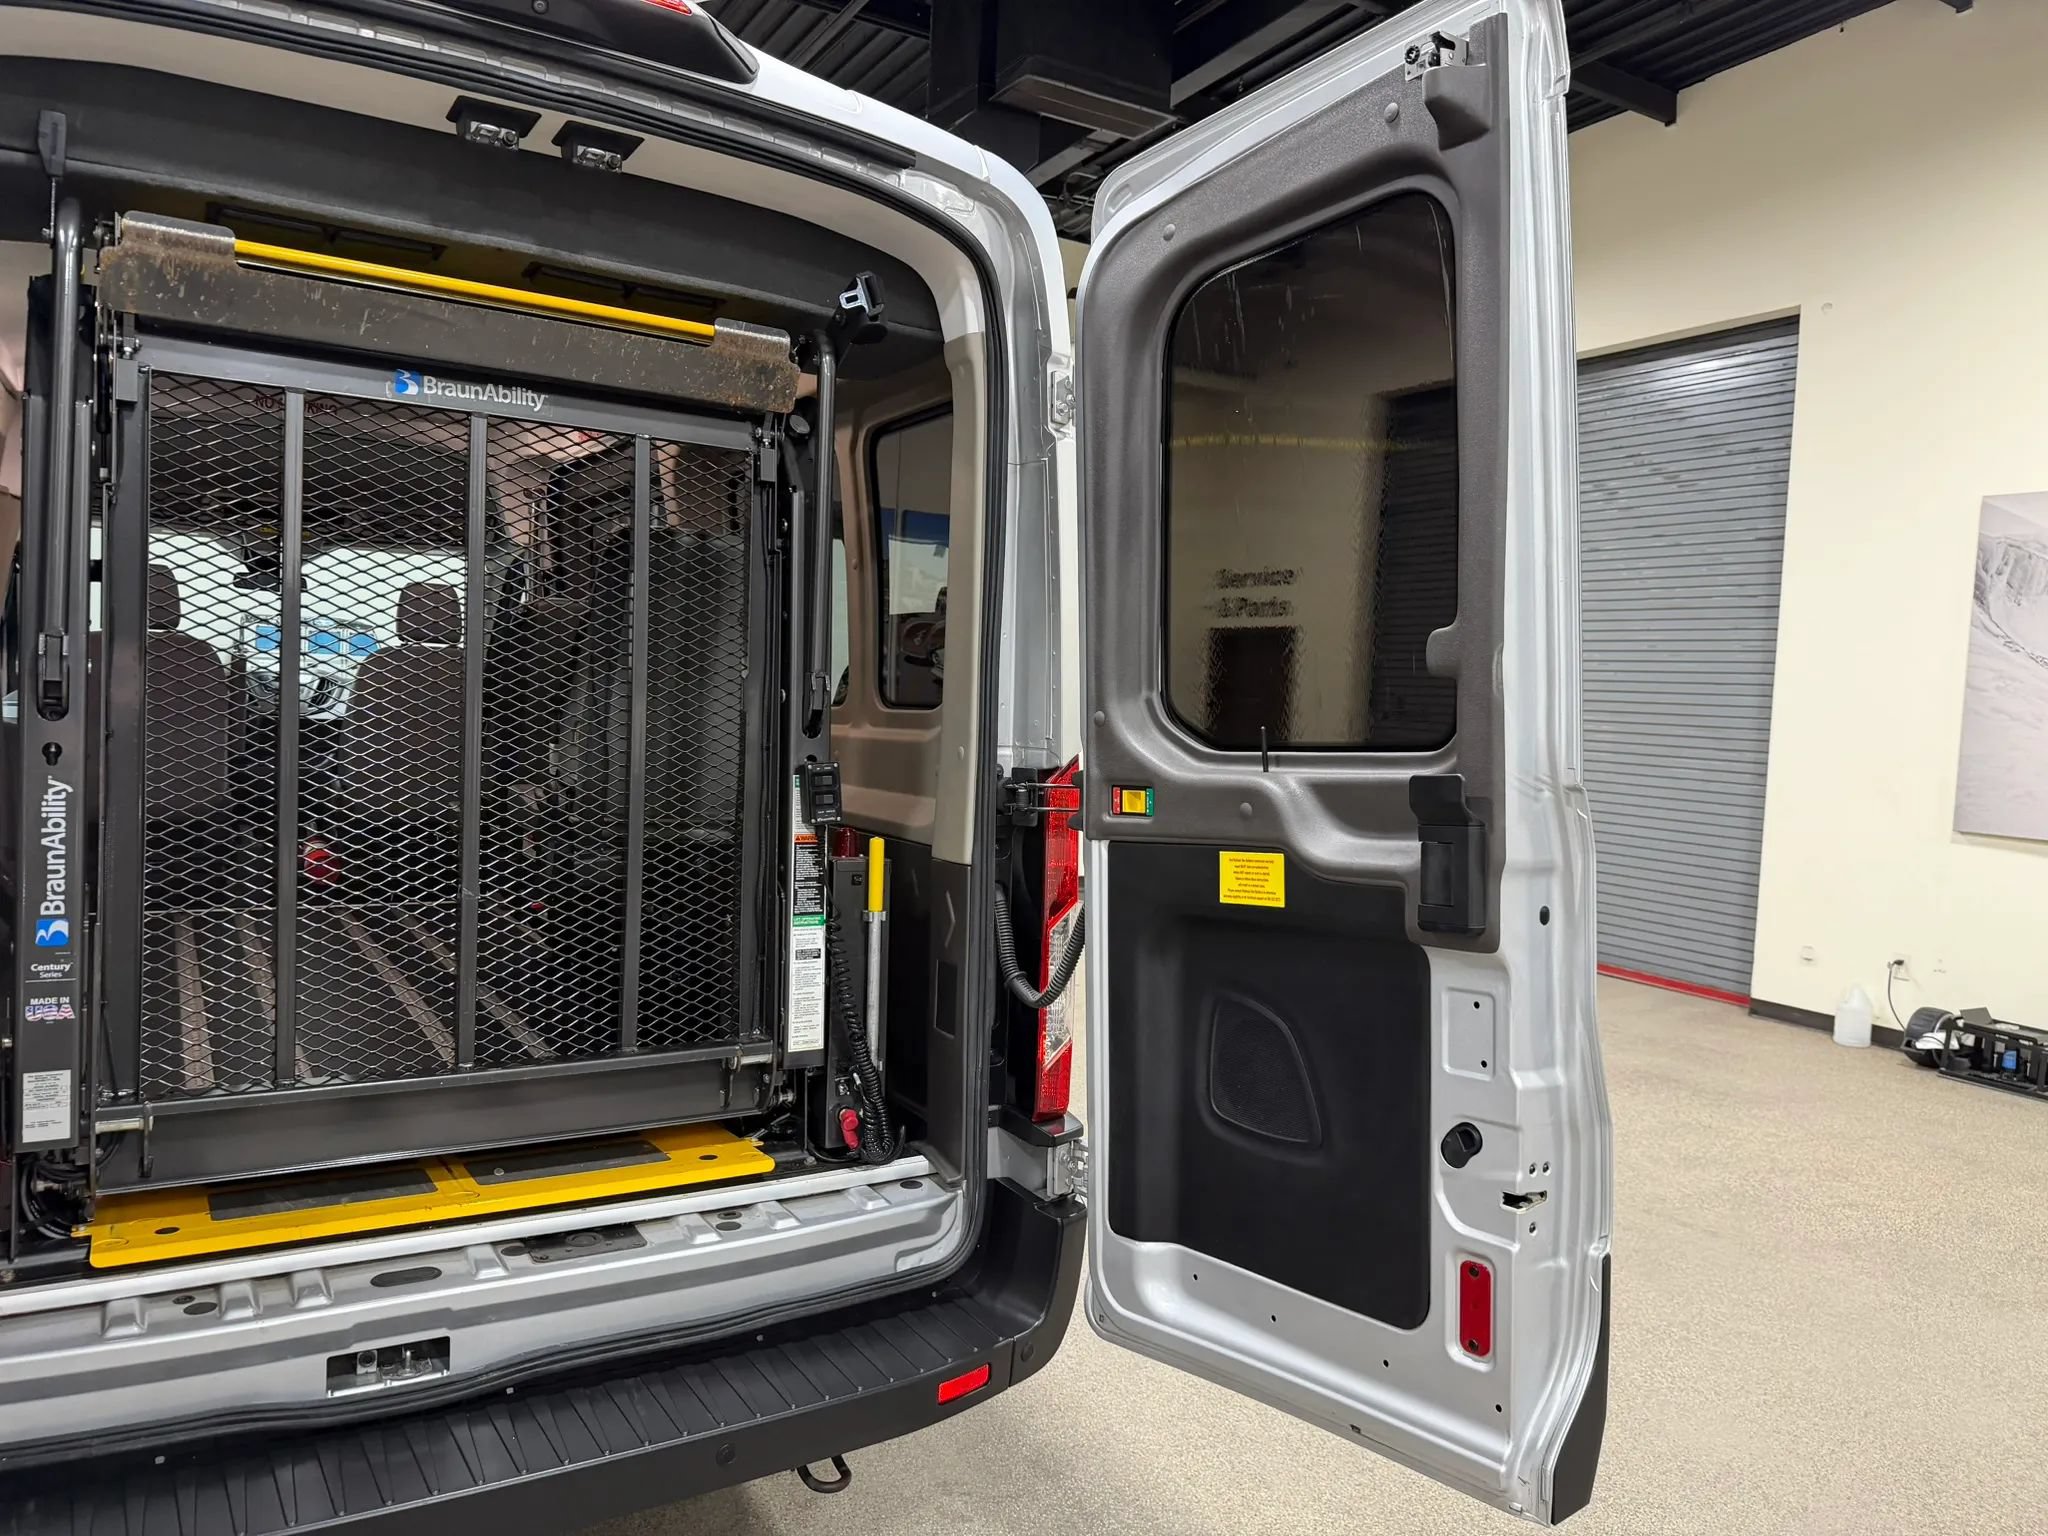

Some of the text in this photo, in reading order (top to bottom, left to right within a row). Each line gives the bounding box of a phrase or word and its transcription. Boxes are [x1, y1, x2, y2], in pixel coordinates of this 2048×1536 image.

[423, 375, 545, 412] BraunAbility
[40, 776, 74, 916] BraunAbility
[30, 963, 72, 972] Century
[30, 996, 70, 1005] MADE IN
[25, 1004, 76, 1022] USA
